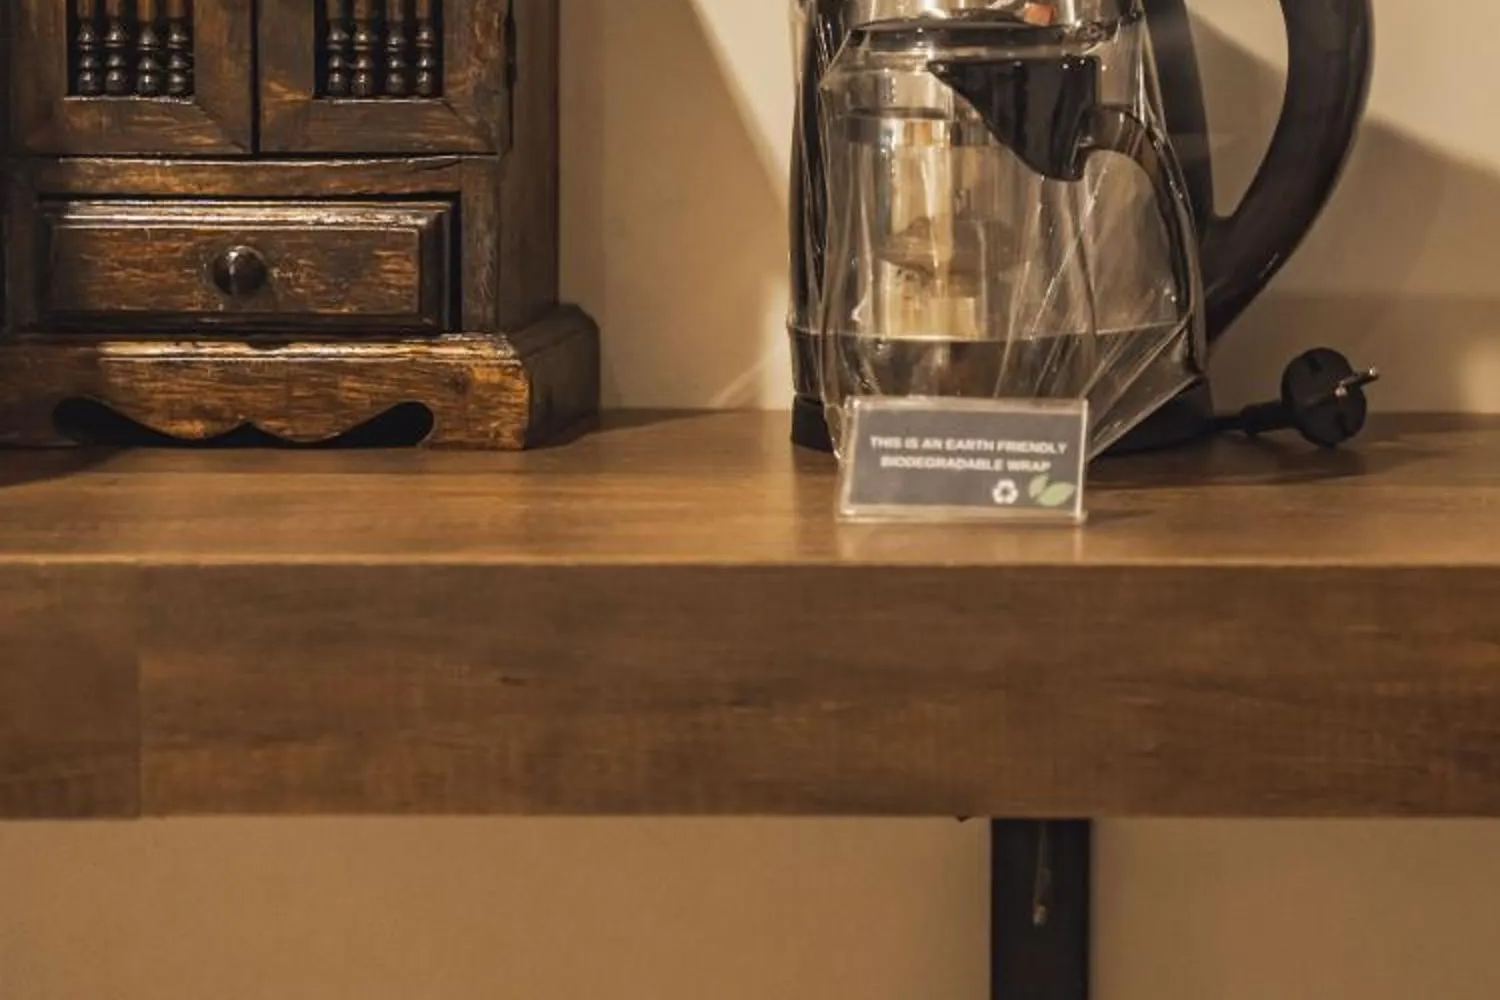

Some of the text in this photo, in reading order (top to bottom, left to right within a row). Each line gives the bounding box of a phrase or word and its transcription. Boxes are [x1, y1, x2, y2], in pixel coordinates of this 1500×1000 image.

[870, 434, 1068, 455] THIS IS AN EARTH FRIENDLY
[880, 456, 1052, 473] BIODEGRADABLE WRAP
